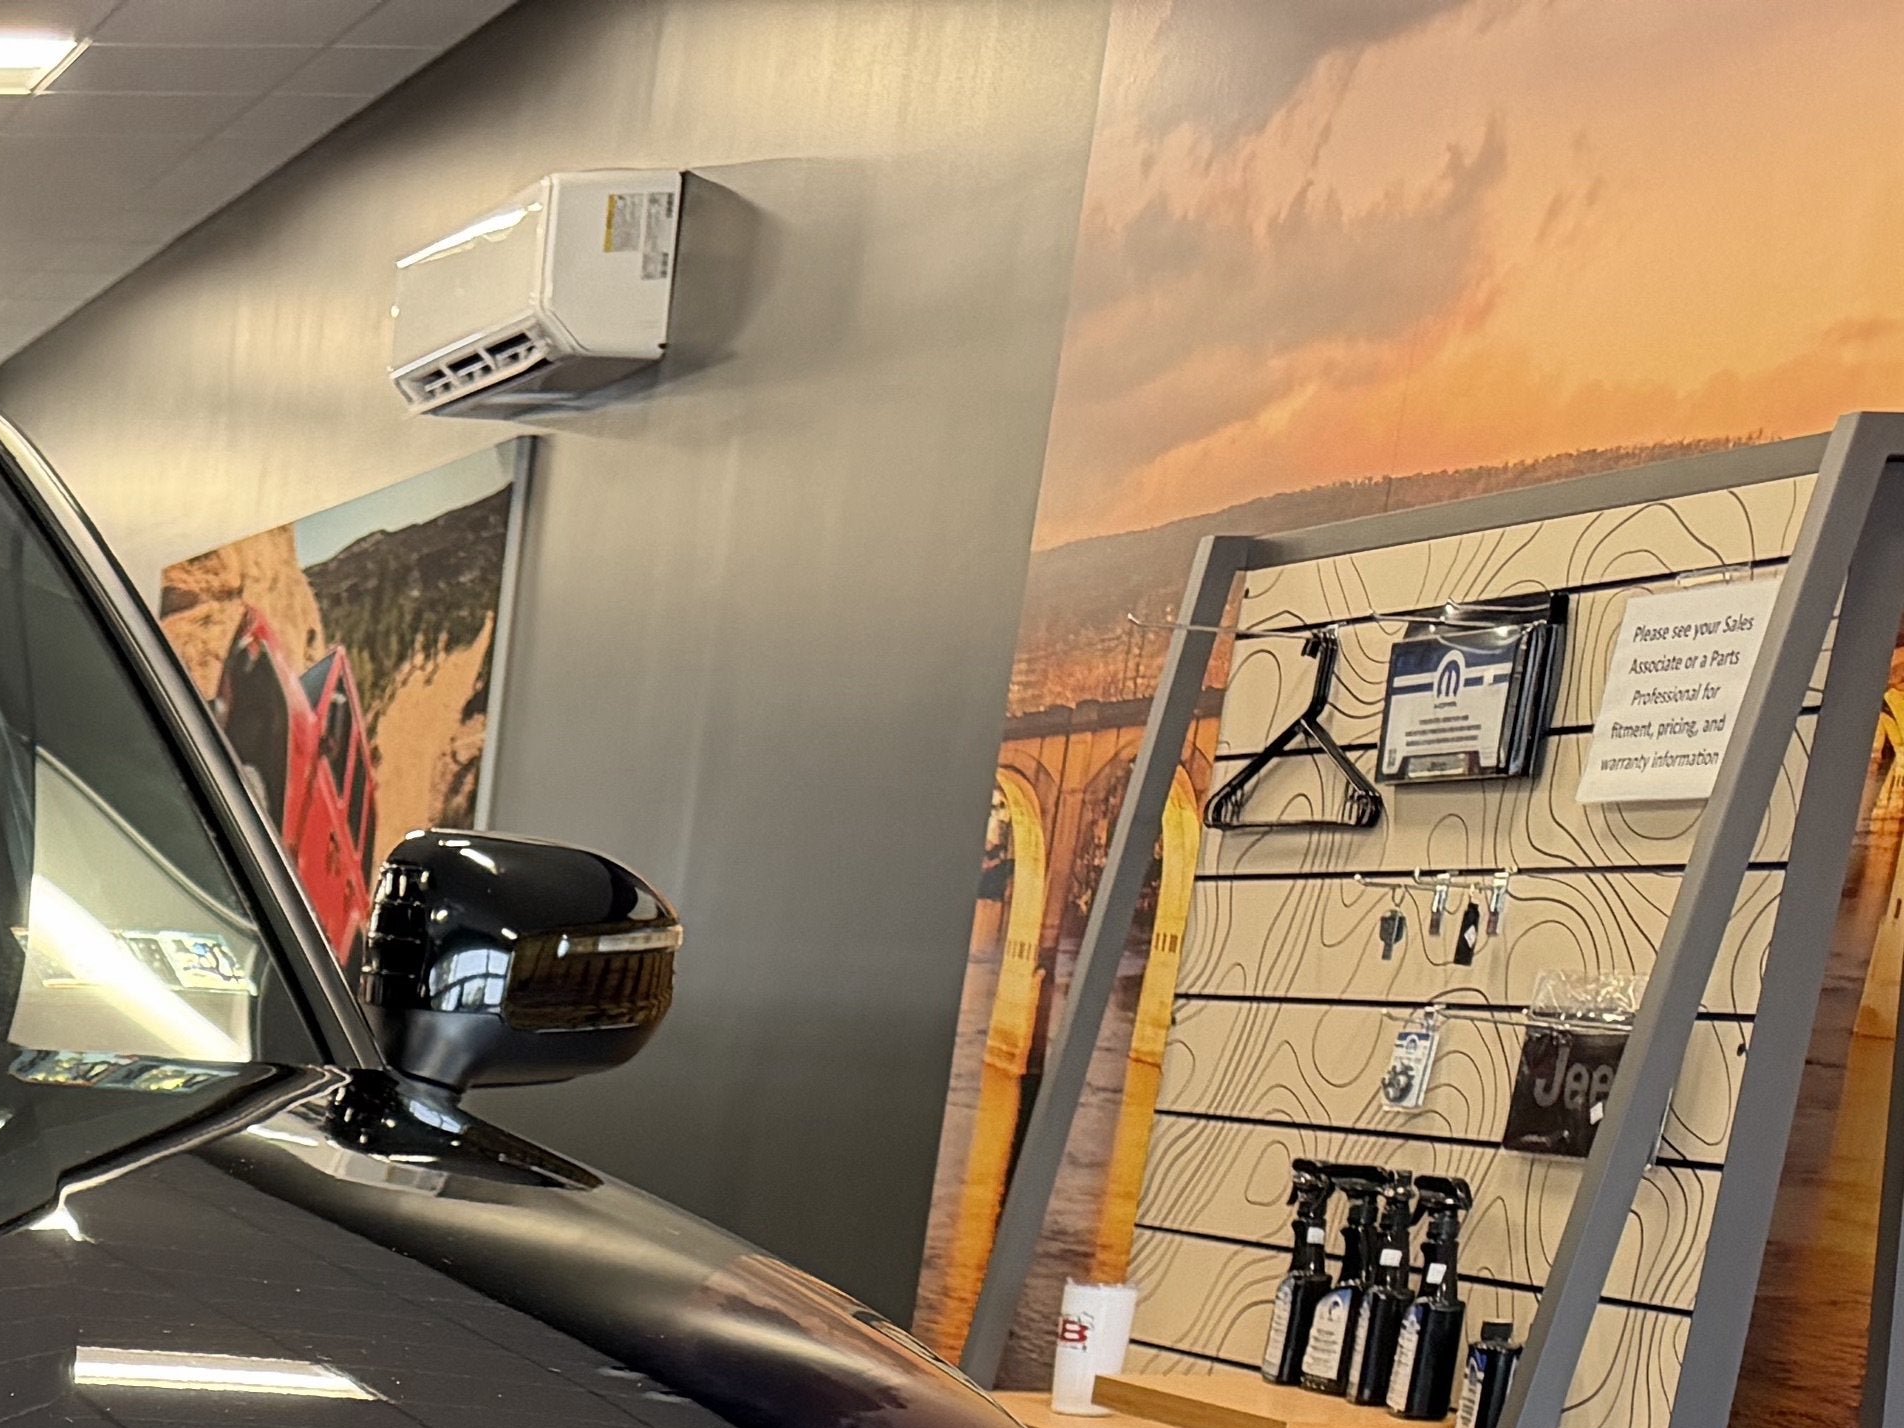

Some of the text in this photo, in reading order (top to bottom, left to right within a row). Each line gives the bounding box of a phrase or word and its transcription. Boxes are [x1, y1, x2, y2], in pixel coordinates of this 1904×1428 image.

[1633, 613, 1755, 643] Please see your Sales
[1628, 649, 1741, 676] Associate or a Parts
[1630, 681, 1722, 706] Professional for
[1610, 714, 1727, 740] fitment, pricing, and
[1600, 748, 1720, 773] warranty information
[1533, 1043, 1615, 1111] Jee
